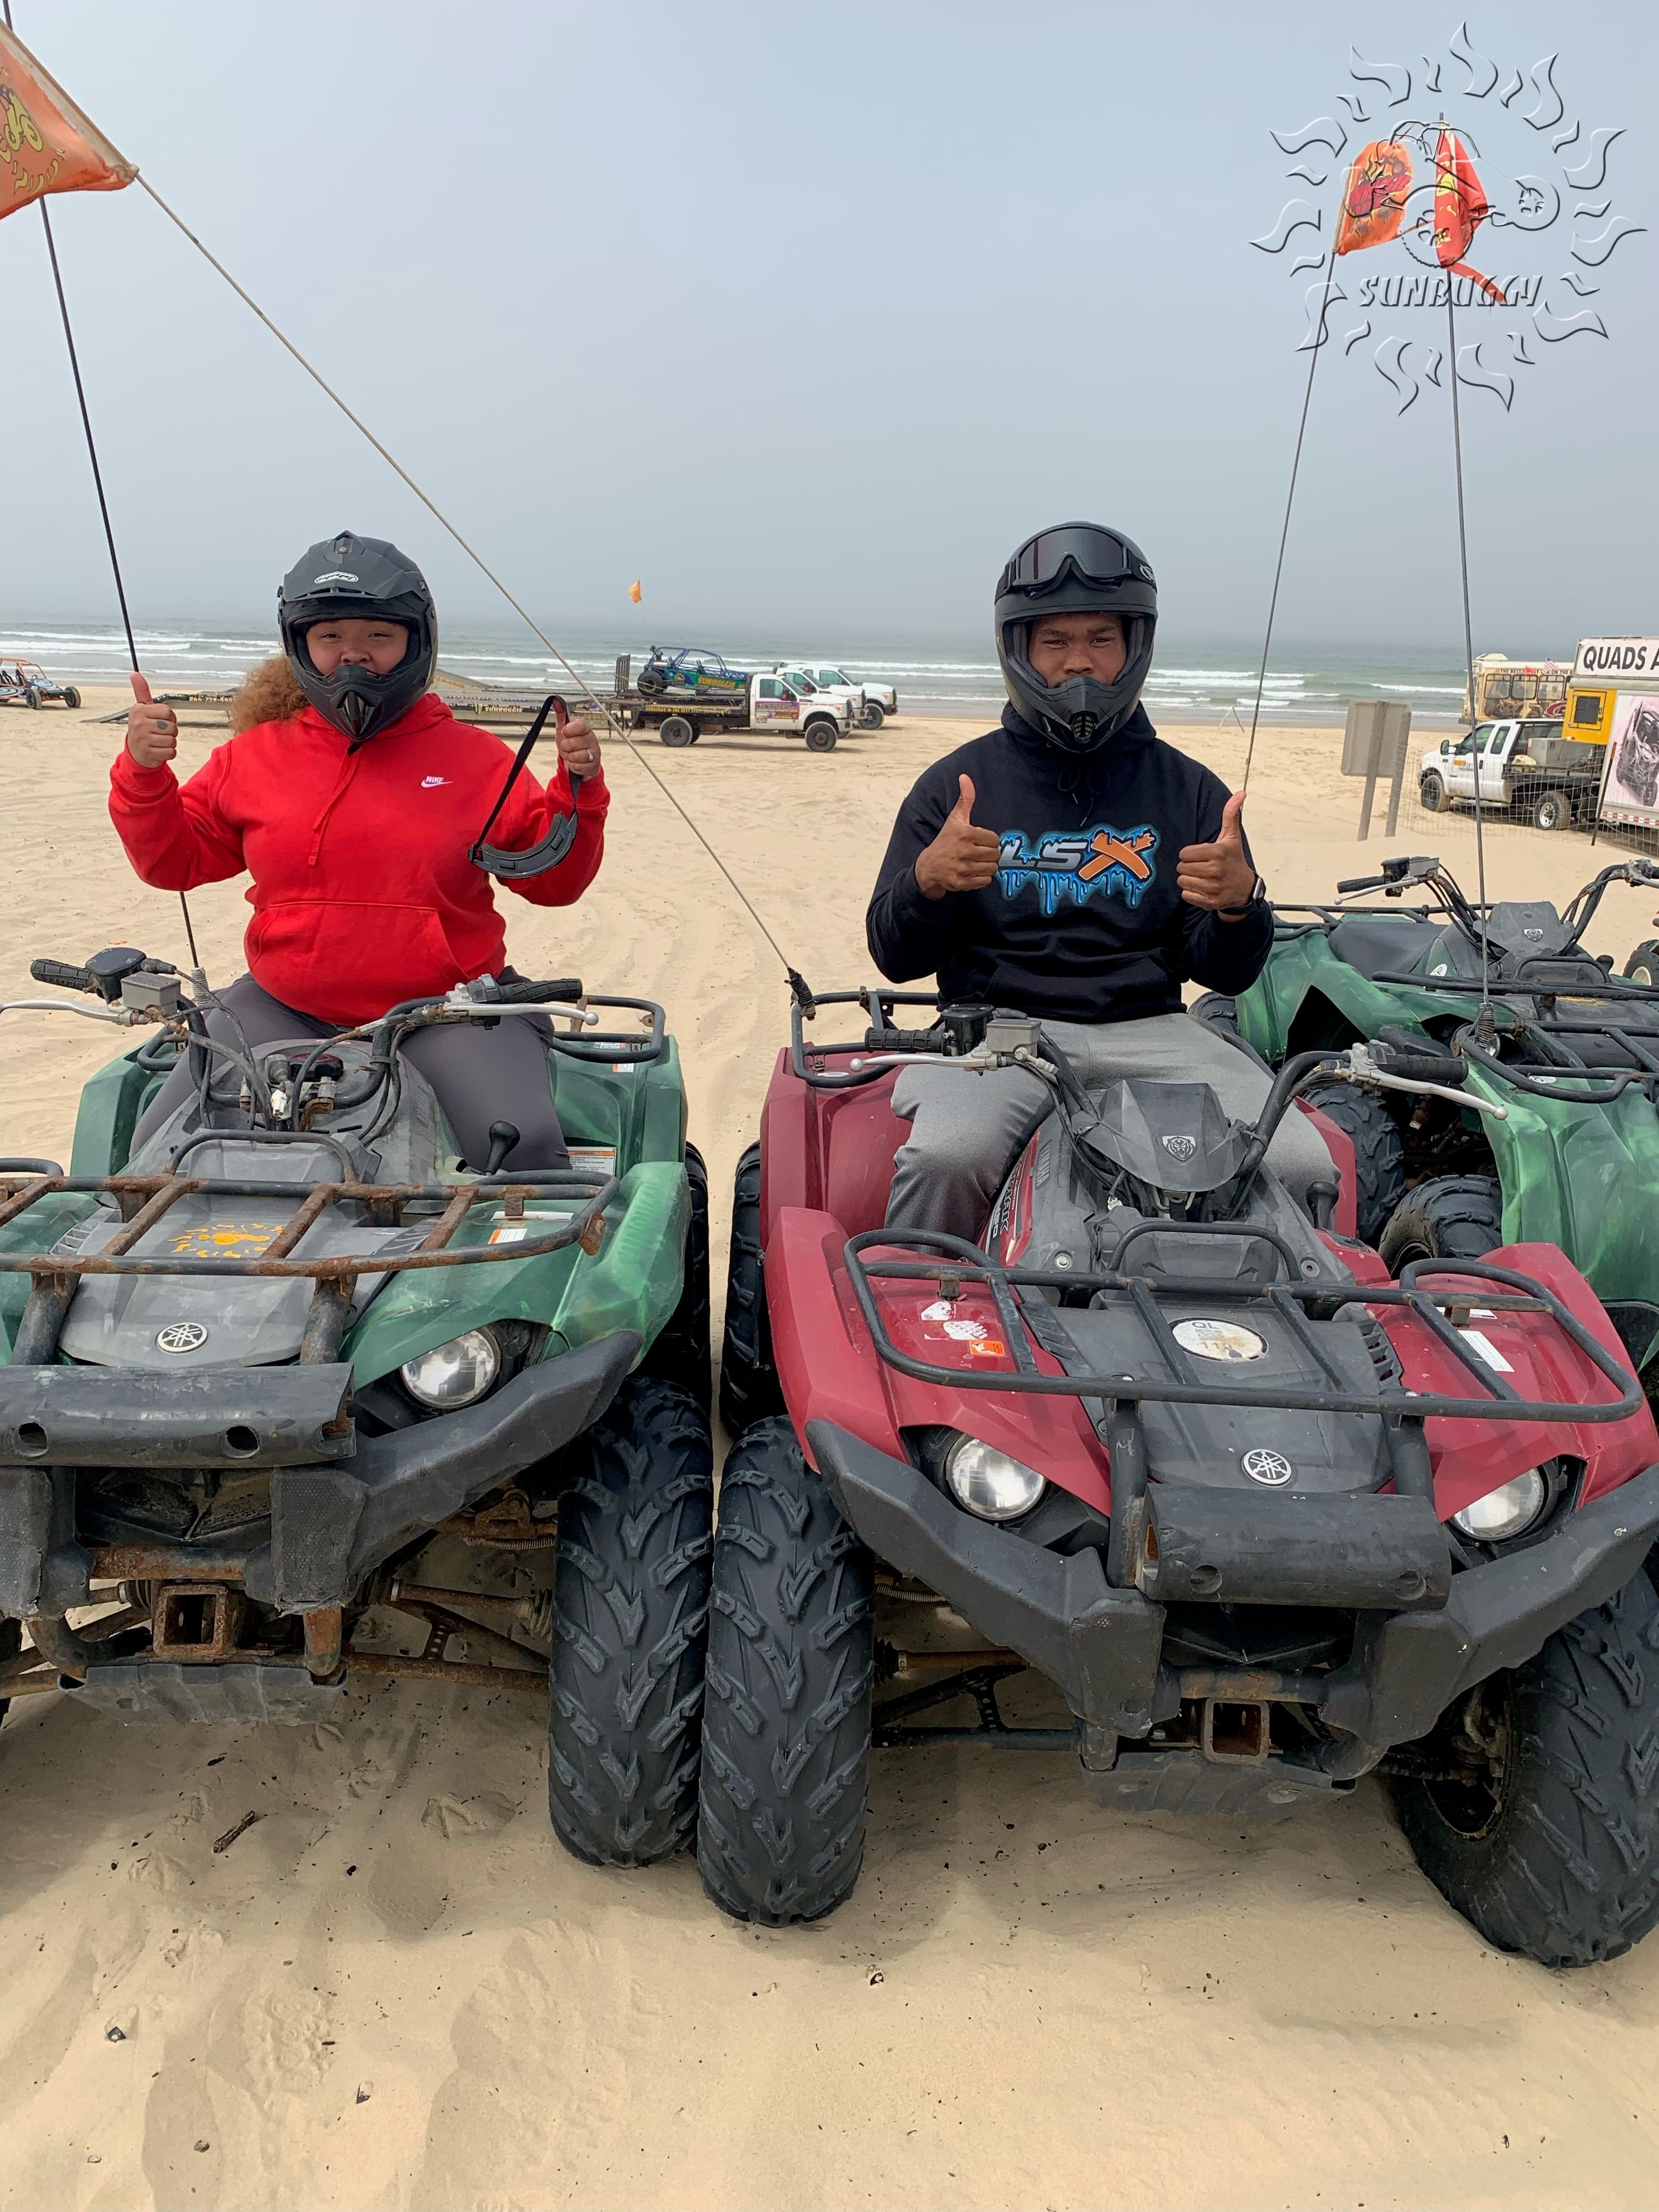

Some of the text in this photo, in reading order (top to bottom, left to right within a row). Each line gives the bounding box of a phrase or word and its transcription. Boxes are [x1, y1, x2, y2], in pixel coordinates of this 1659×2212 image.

[1583, 646, 1647, 671] QUADS
[998, 830, 1155, 881] LSX
[1036, 1141, 1050, 1187] YAMAHA
[1192, 1321, 1220, 1329] QL
